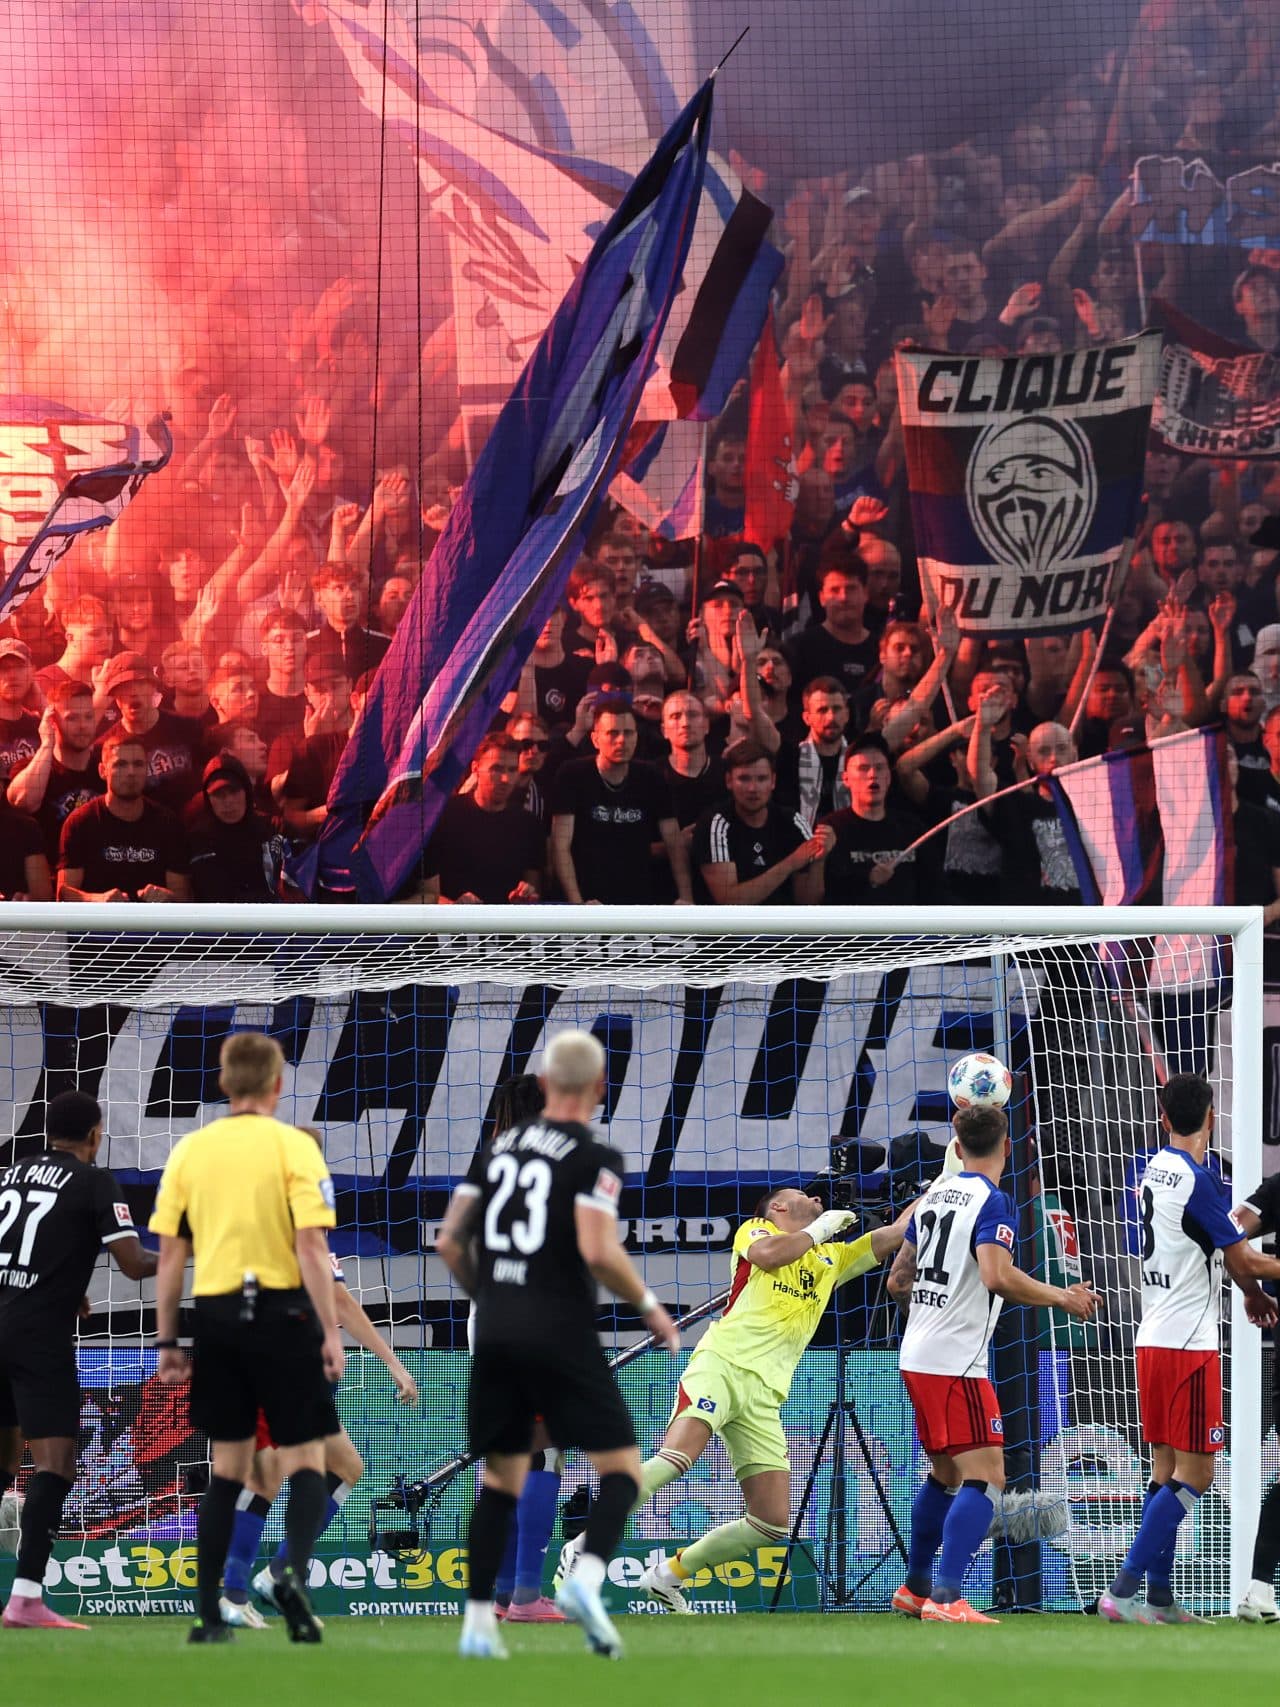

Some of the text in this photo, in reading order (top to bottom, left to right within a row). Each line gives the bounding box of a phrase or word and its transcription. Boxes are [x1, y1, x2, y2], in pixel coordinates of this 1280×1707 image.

[917, 344, 1137, 415] CLIQUE
[940, 565, 1107, 619] DU NOR
[1, 1165, 73, 1190] ST. PAULI
[484, 1152, 553, 1255] 23
[0, 1188, 58, 1267] 27
[913, 1209, 957, 1286] 21
[86, 1599, 195, 1614] SPORTWETTEN
[349, 1601, 459, 1615] SPORTWETTEN
